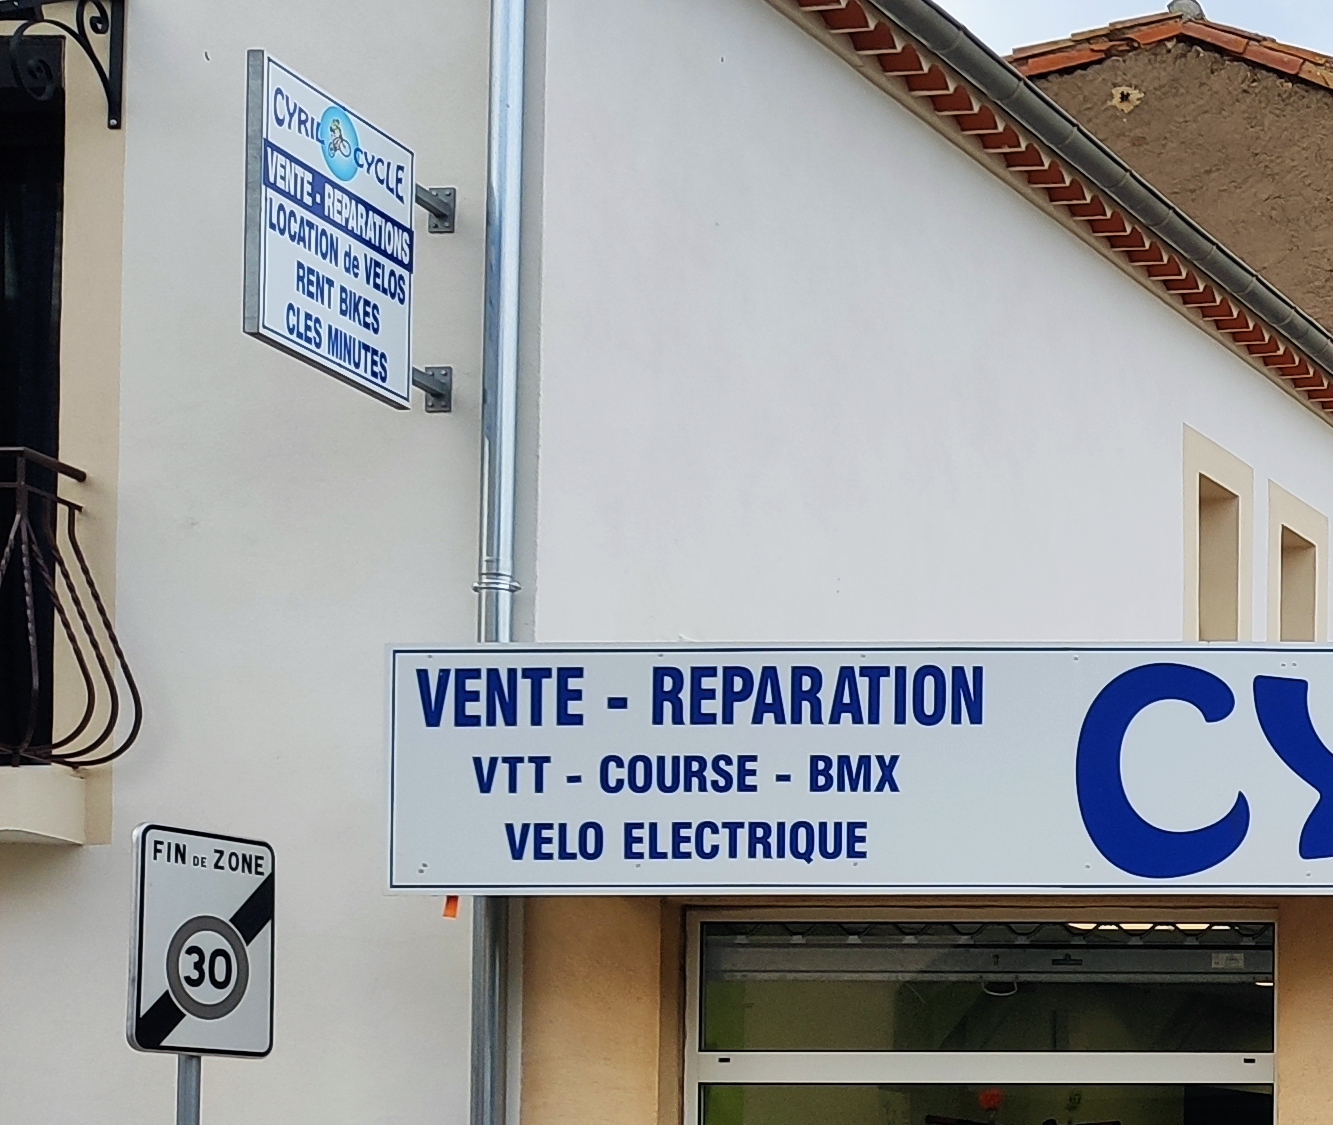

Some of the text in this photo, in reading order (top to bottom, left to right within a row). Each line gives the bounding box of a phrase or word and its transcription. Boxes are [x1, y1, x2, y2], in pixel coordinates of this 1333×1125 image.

[273, 87, 405, 205] CYRIL CYCLE
[266, 146, 313, 207] VENTE
[324, 182, 411, 266] REPARATIONS
[268, 197, 406, 306] LOCATION de VELOS
[296, 260, 380, 335] RENT BIKES
[286, 303, 388, 384] CLES MINUTES
[415, 667, 585, 728] VENTE
[651, 664, 985, 727] REPARATION
[472, 755, 552, 794] VTT
[599, 754, 759, 794] COURSE
[809, 754, 900, 793] BMX
[153, 839, 265, 876] FIN DE ZONE
[505, 821, 868, 864] VELO ELECTRIQUE
[183, 945, 233, 990] 30
